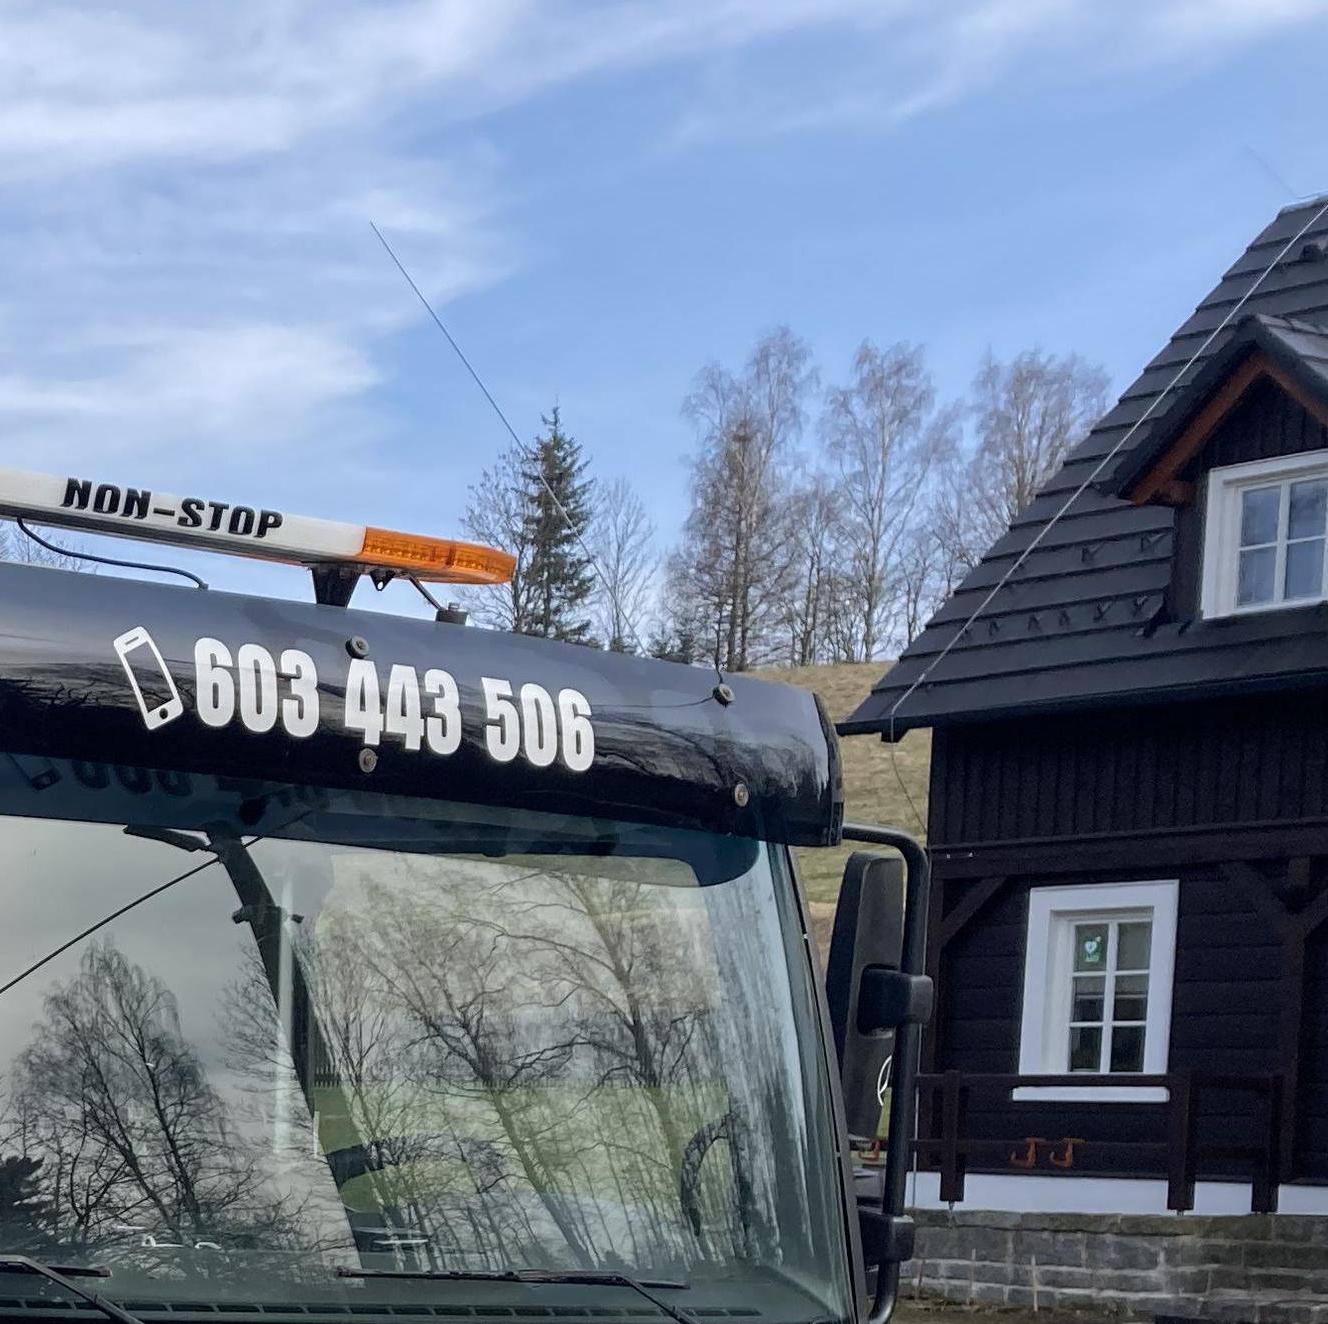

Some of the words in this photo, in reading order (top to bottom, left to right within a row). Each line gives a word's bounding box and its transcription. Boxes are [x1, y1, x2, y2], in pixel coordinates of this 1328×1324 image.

[61, 477, 283, 539] NON-STOP
[194, 636, 319, 739] 603
[344, 657, 461, 755] 443
[484, 678, 596, 773] 506
